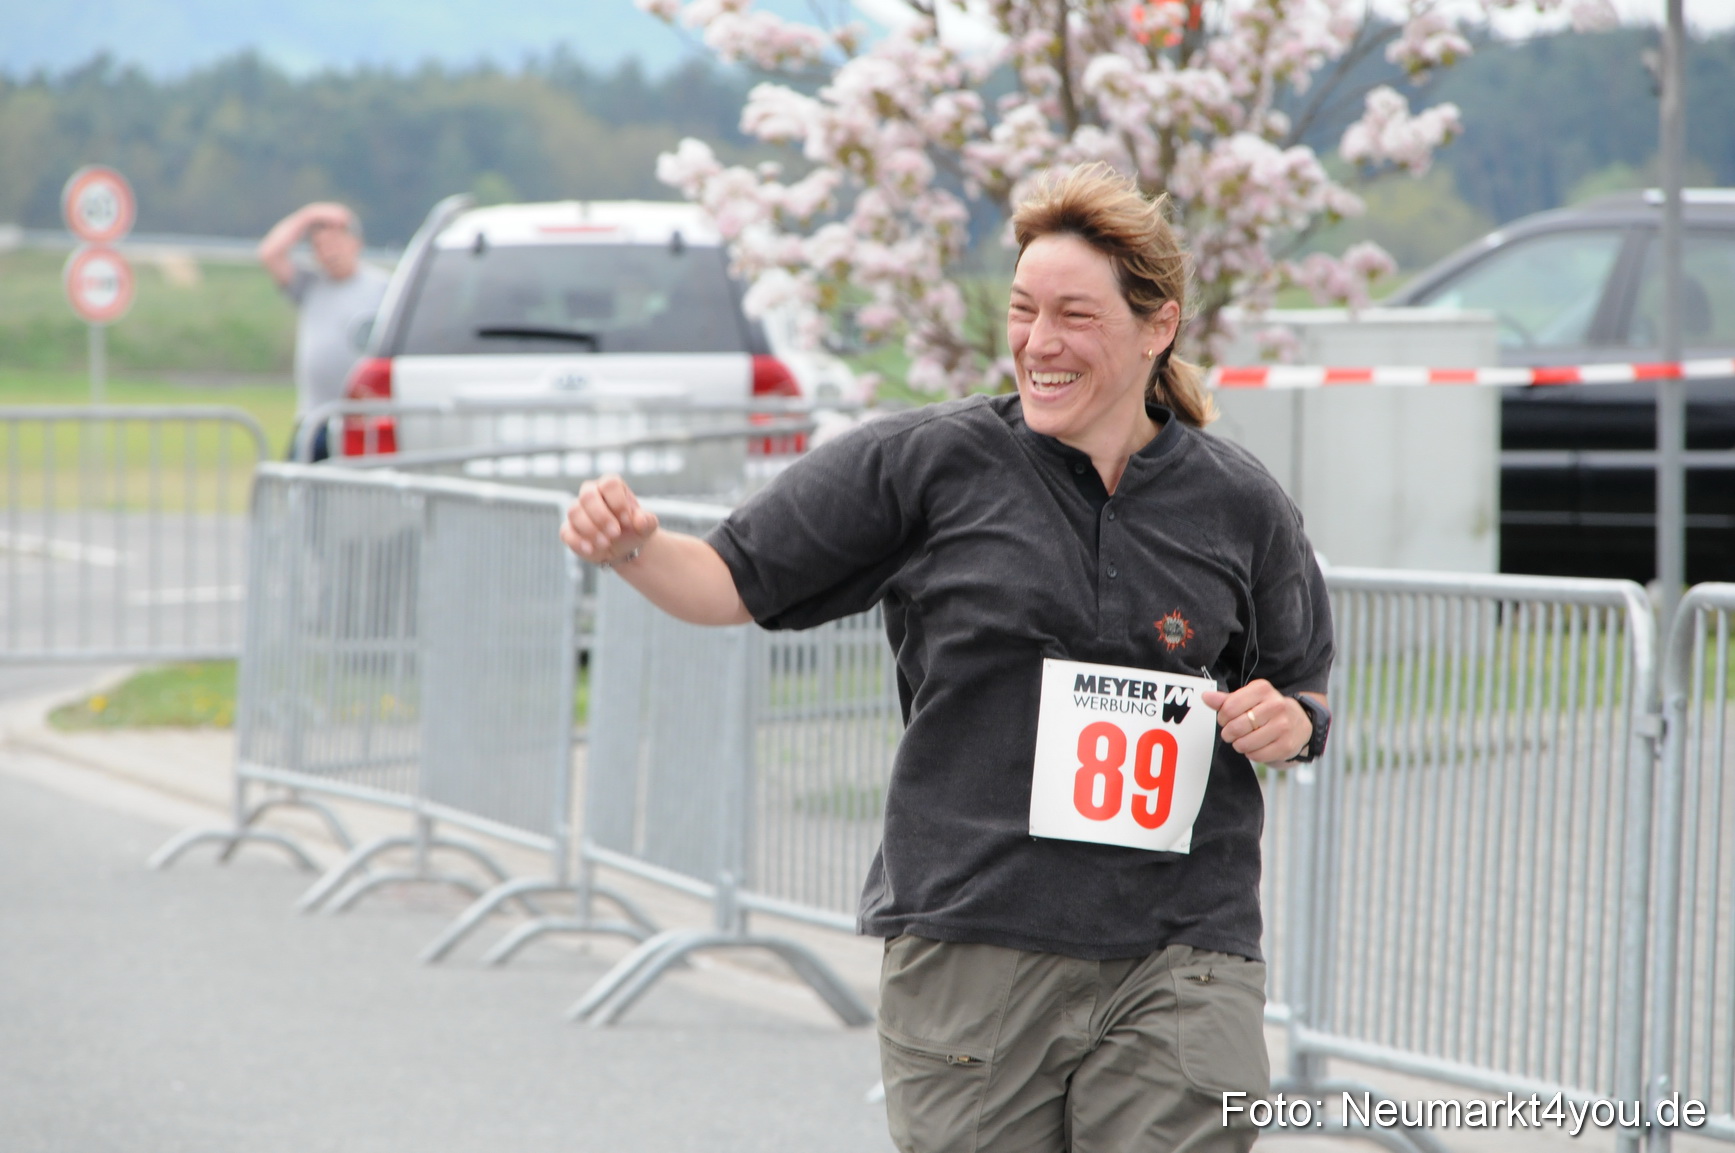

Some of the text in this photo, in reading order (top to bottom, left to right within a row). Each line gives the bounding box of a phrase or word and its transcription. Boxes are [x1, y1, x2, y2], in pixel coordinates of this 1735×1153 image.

[1073, 674, 1158, 701] MEYER
[1073, 694, 1158, 717] WERBUNG
[1073, 721, 1178, 830] 89
